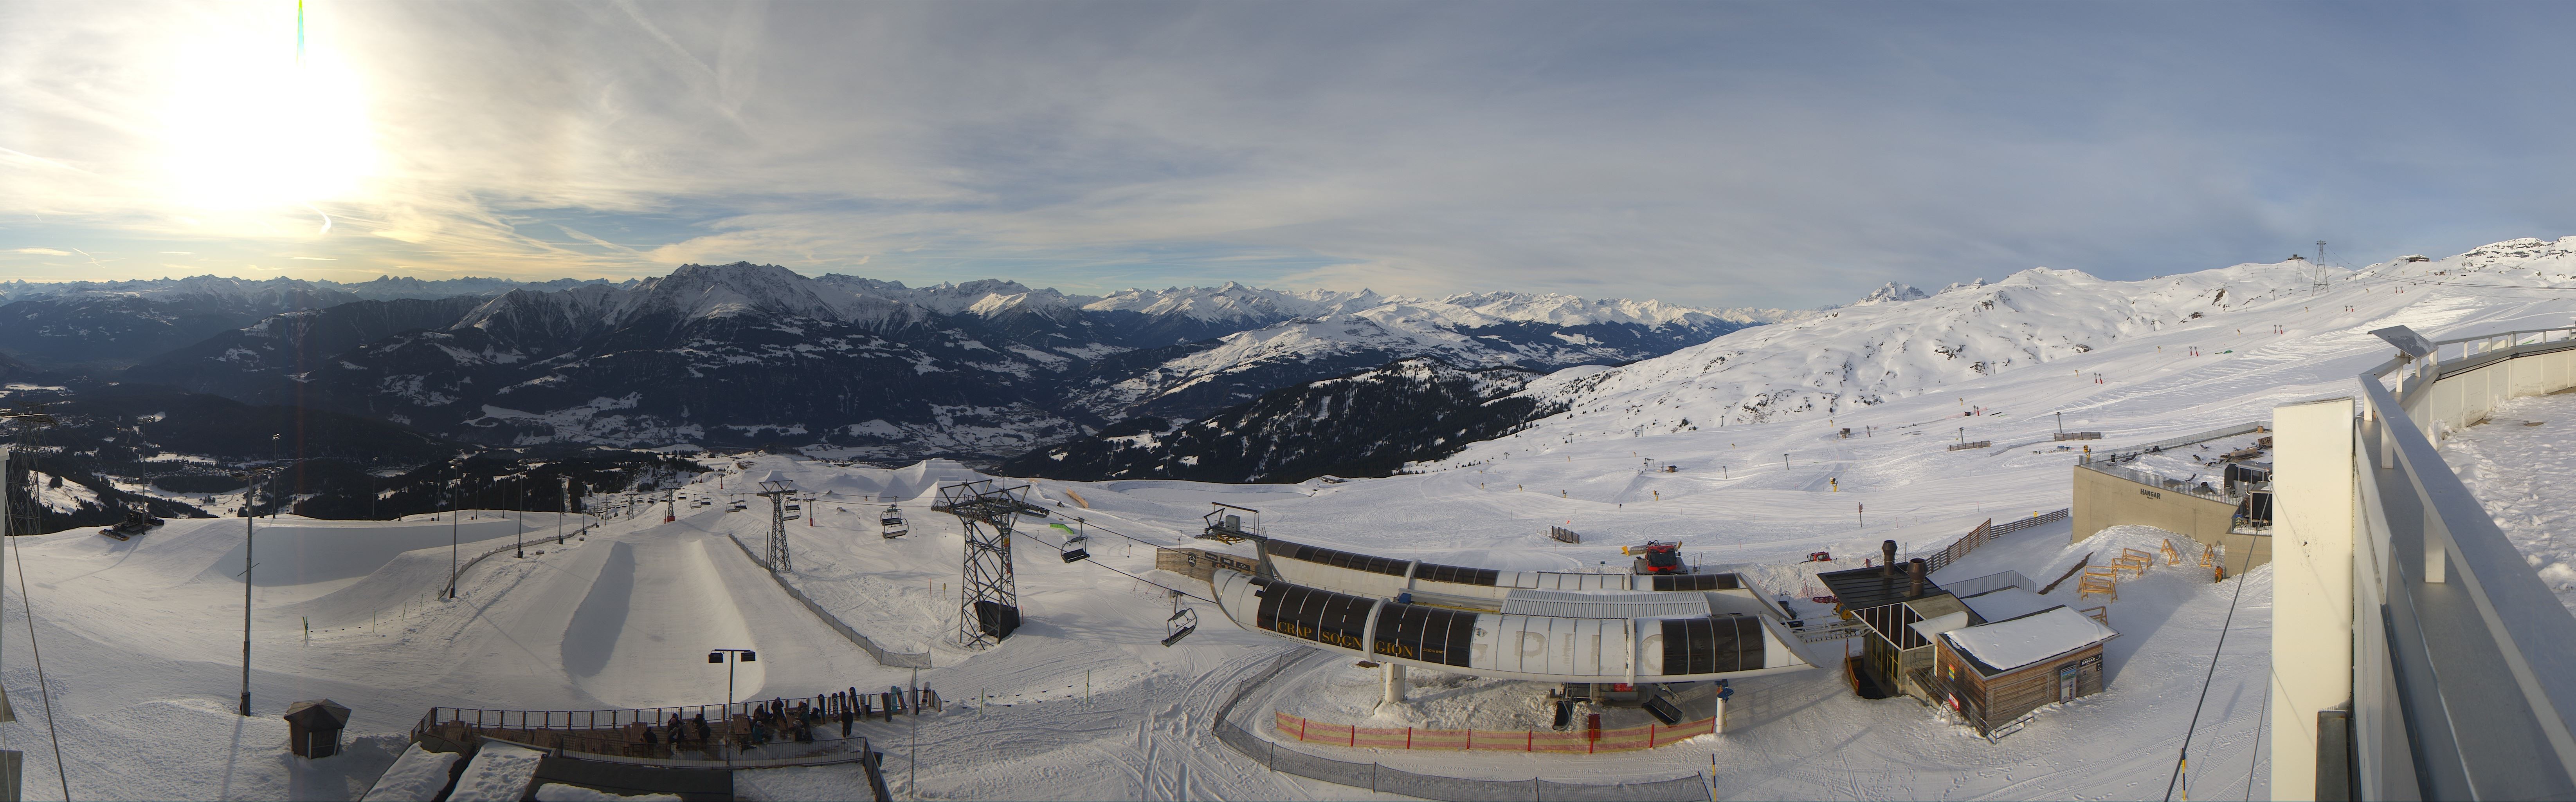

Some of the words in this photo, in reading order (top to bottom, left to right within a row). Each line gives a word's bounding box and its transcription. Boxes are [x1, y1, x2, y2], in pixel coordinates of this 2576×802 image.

[2140, 488, 2160, 499] HANGAR
[1260, 630, 1286, 638] CRUISING
[1289, 637, 1317, 645] ALTITUDE
[1278, 621, 1312, 638] CRAP
[1322, 631, 1362, 648] SOGN
[1375, 641, 1413, 657] GION
